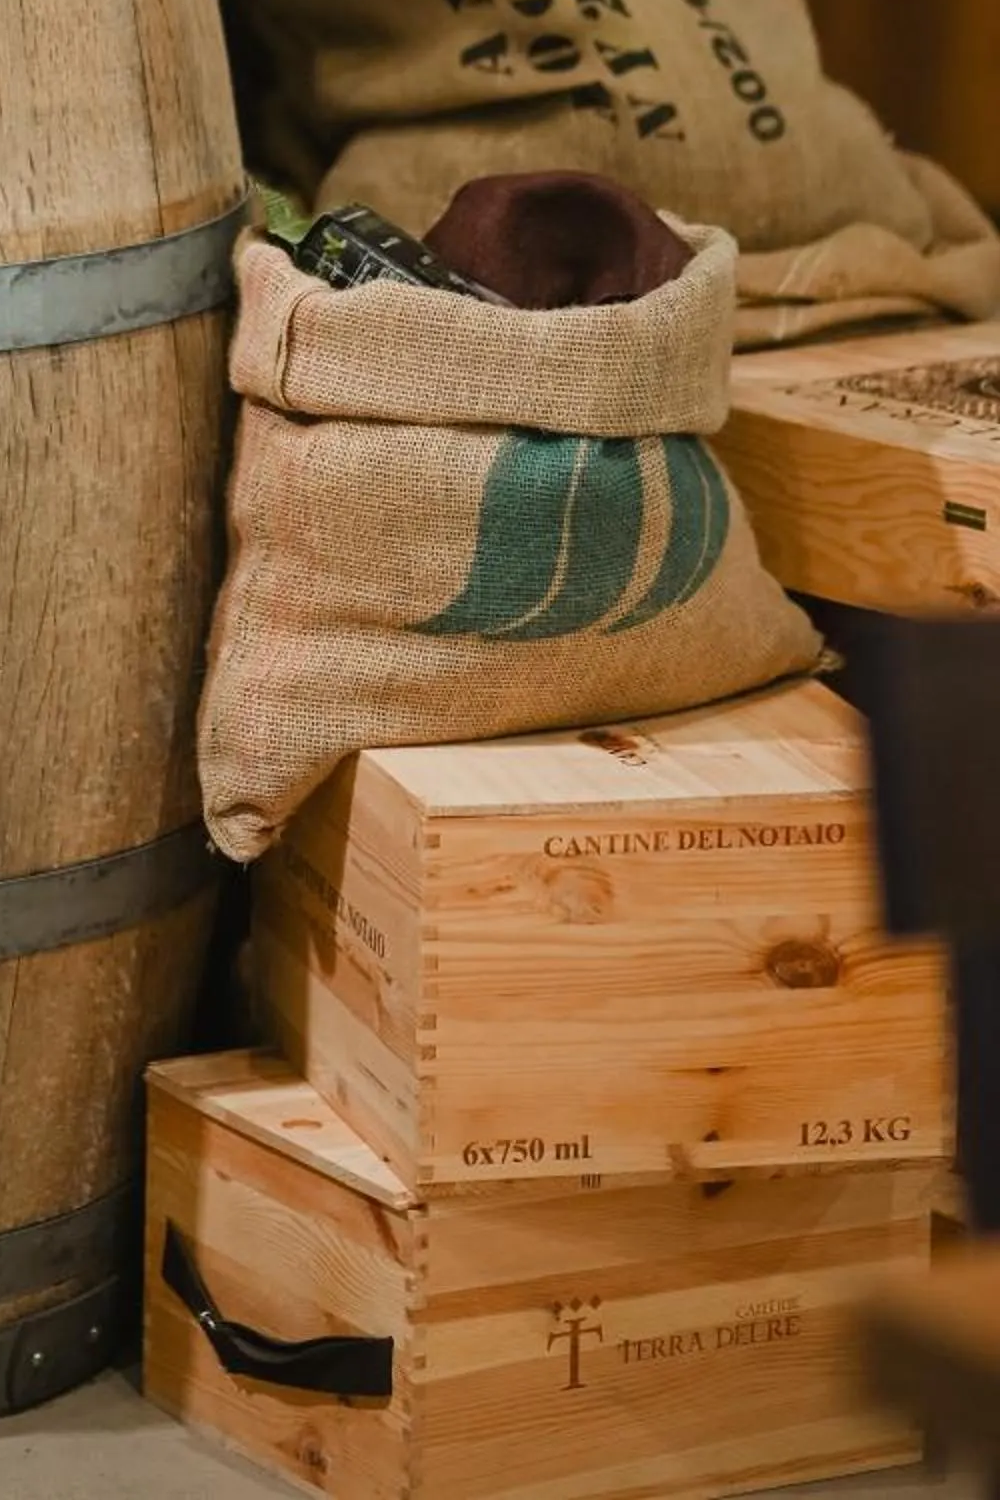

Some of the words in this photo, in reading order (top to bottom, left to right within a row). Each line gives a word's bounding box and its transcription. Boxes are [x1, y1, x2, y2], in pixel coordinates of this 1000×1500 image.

[544, 830, 670, 859] CANTINE
[678, 828, 733, 851] DEL
[737, 822, 846, 848] NOTAIO
[863, 1116, 911, 1144] KG
[462, 1138, 545, 1166] 6x750
[554, 1134, 593, 1161] ml
[617, 1332, 705, 1365] TERRA
